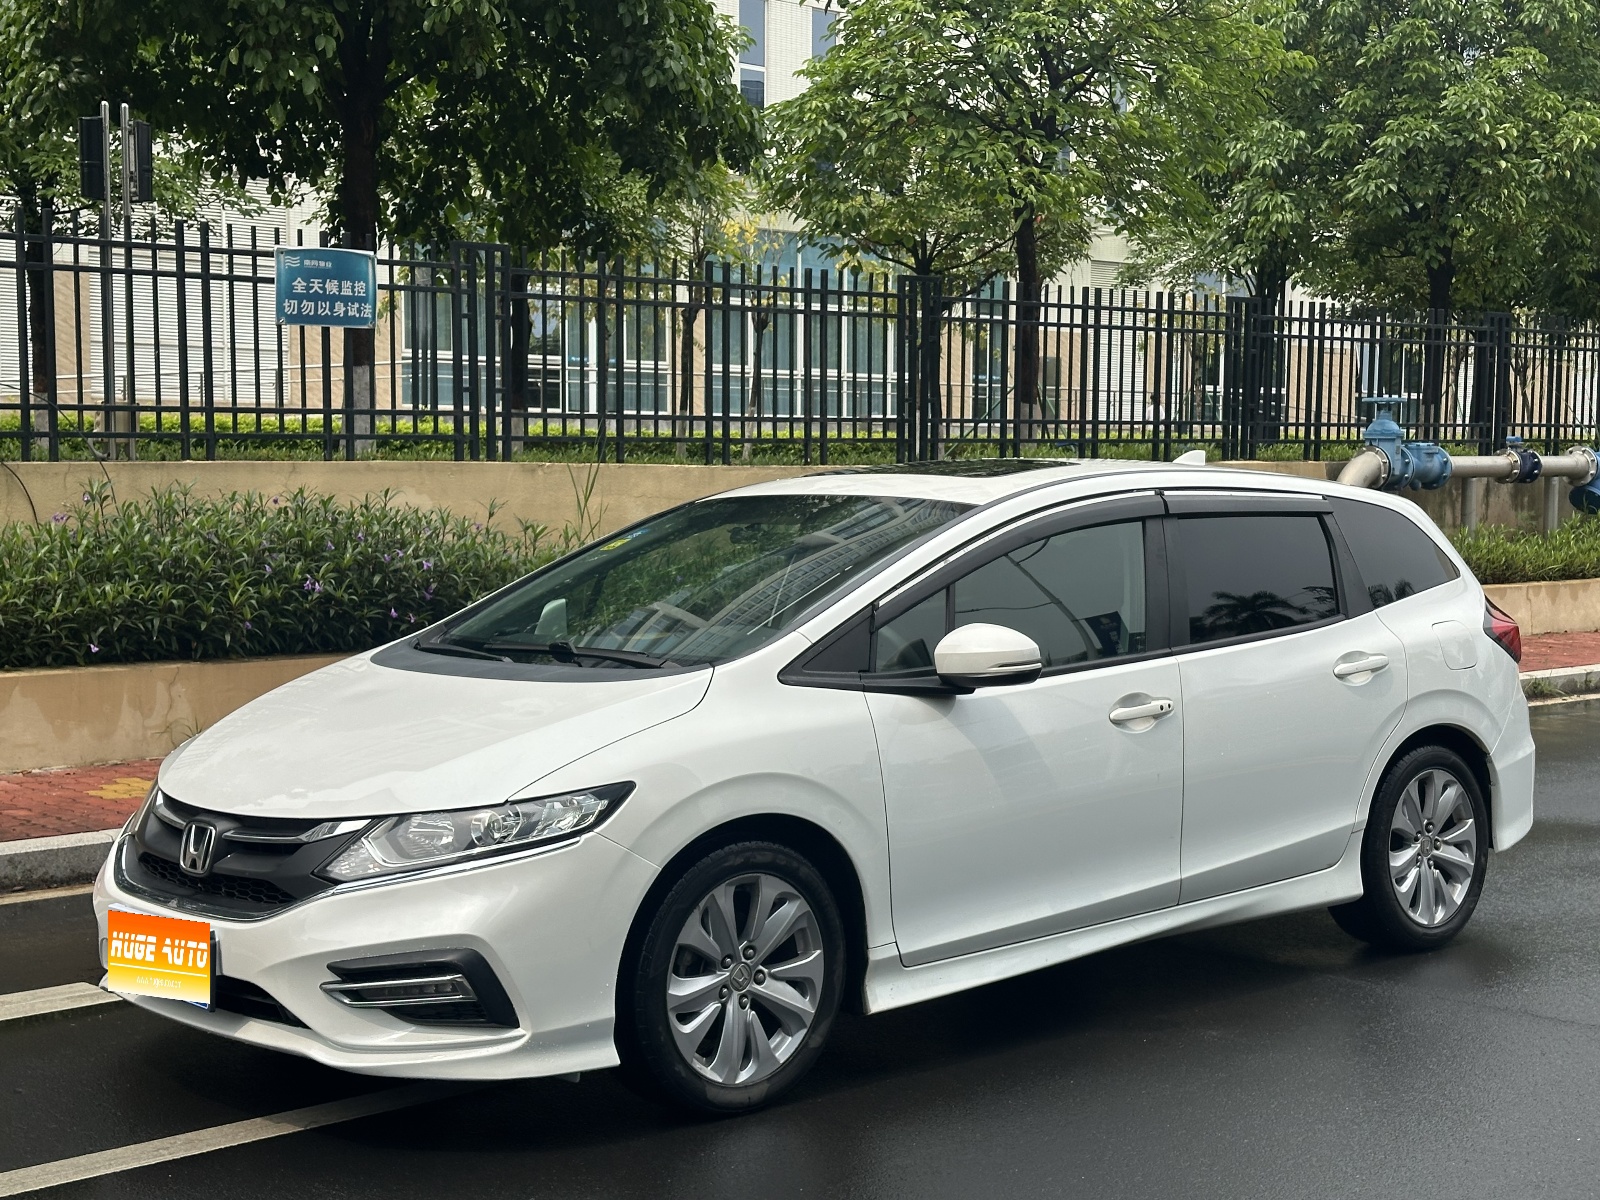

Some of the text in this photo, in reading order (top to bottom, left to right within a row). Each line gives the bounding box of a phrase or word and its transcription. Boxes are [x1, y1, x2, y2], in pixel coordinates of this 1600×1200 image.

[292, 277, 366, 297] 全天候监控
[283, 299, 373, 318] 切勿以身试法
